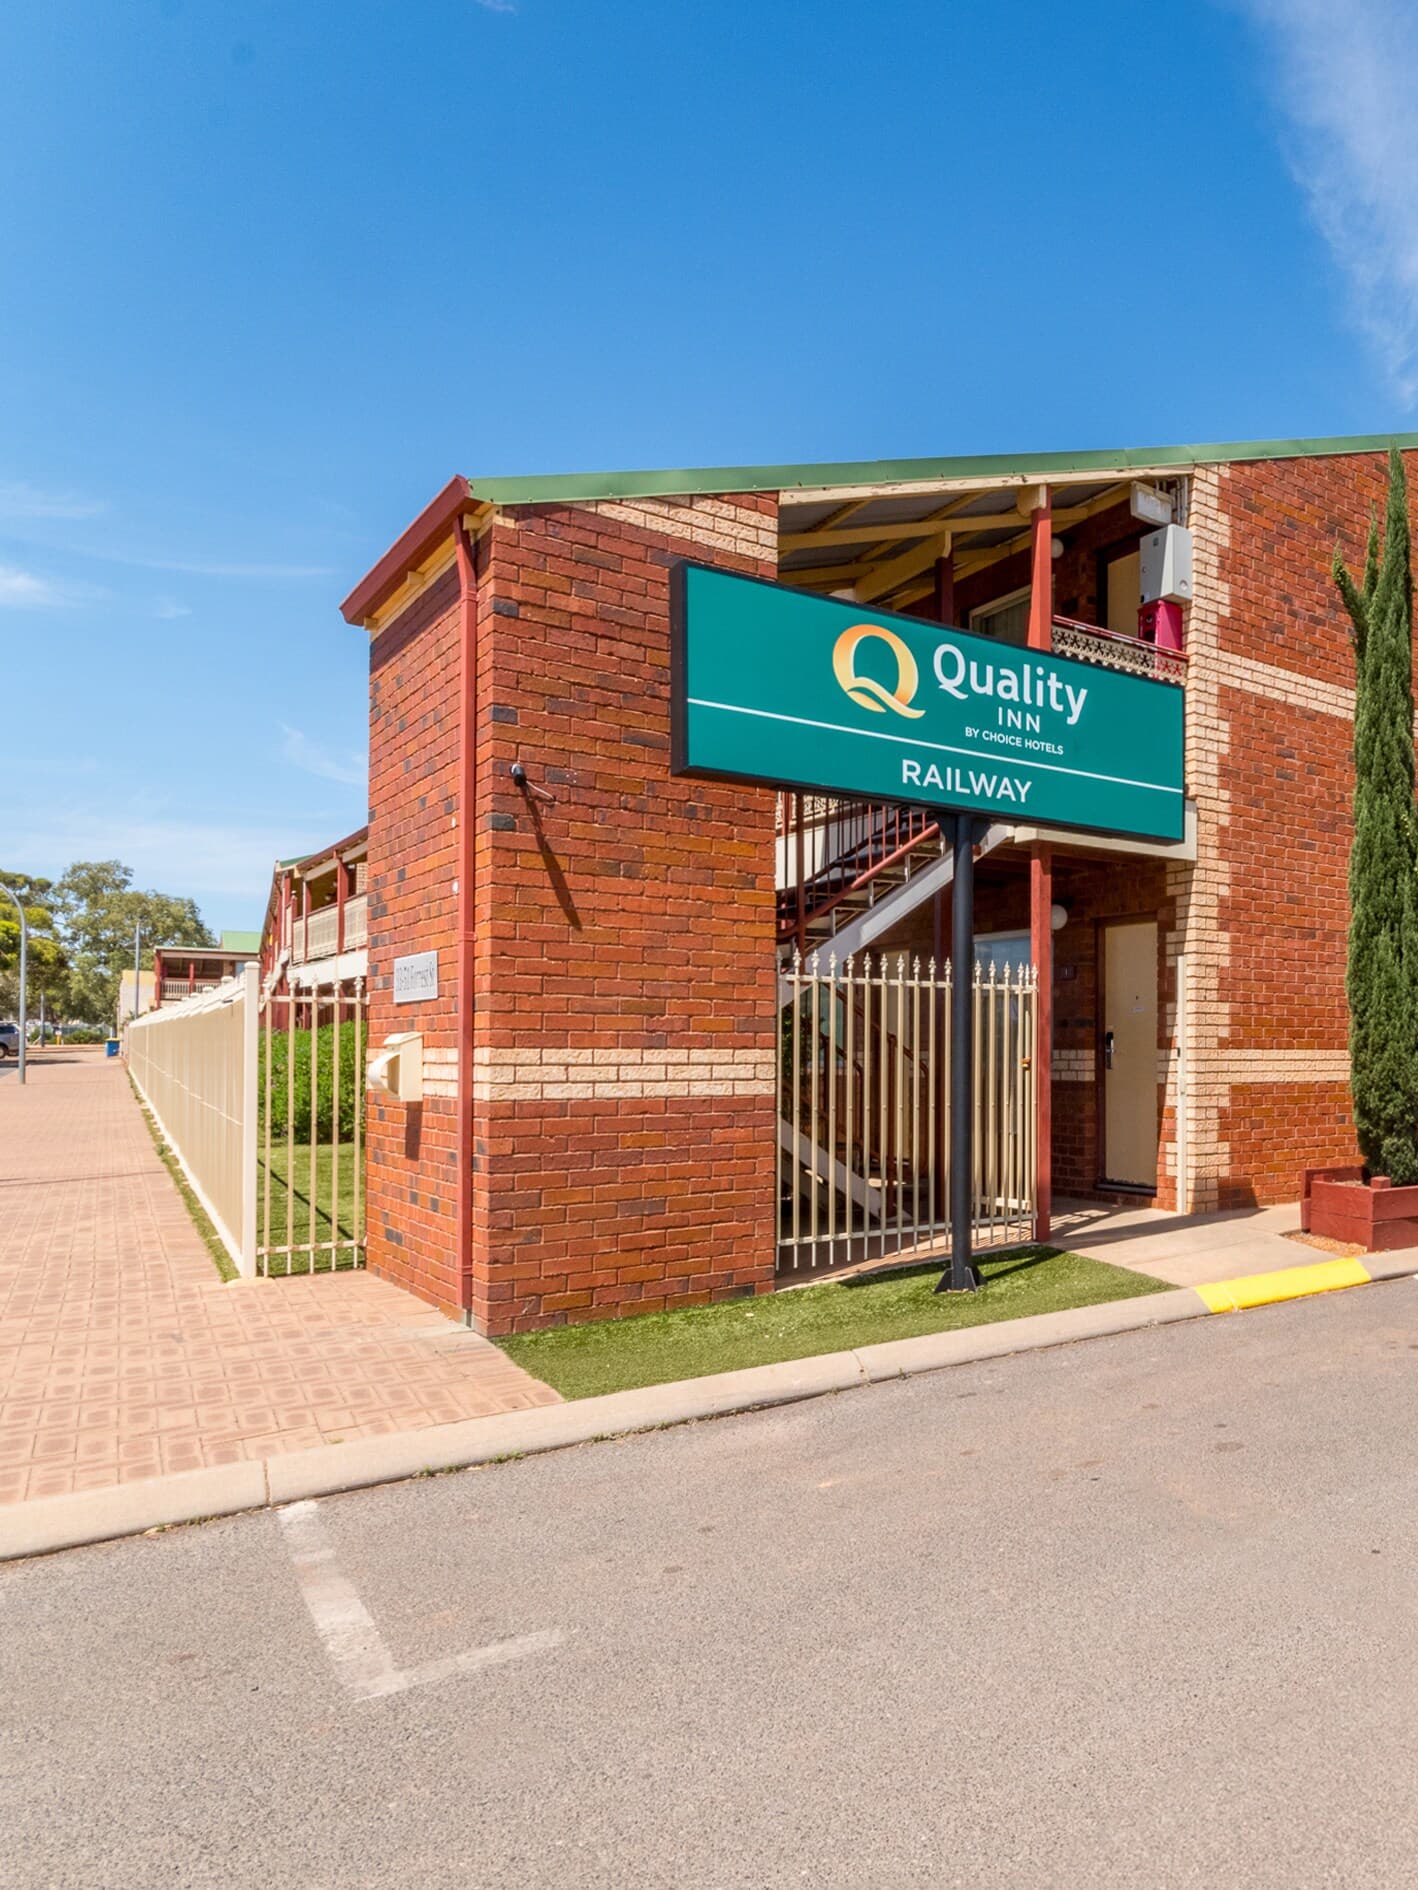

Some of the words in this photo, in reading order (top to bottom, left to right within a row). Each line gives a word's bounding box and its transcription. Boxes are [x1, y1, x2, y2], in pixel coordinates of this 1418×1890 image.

[933, 643, 1088, 725] Quality
[998, 706, 1040, 734] INN
[965, 726, 979, 738] BY
[982, 730, 1022, 747] CHOICE
[1024, 739, 1064, 755] HOTELS
[902, 759, 1032, 803] RAILWAY
